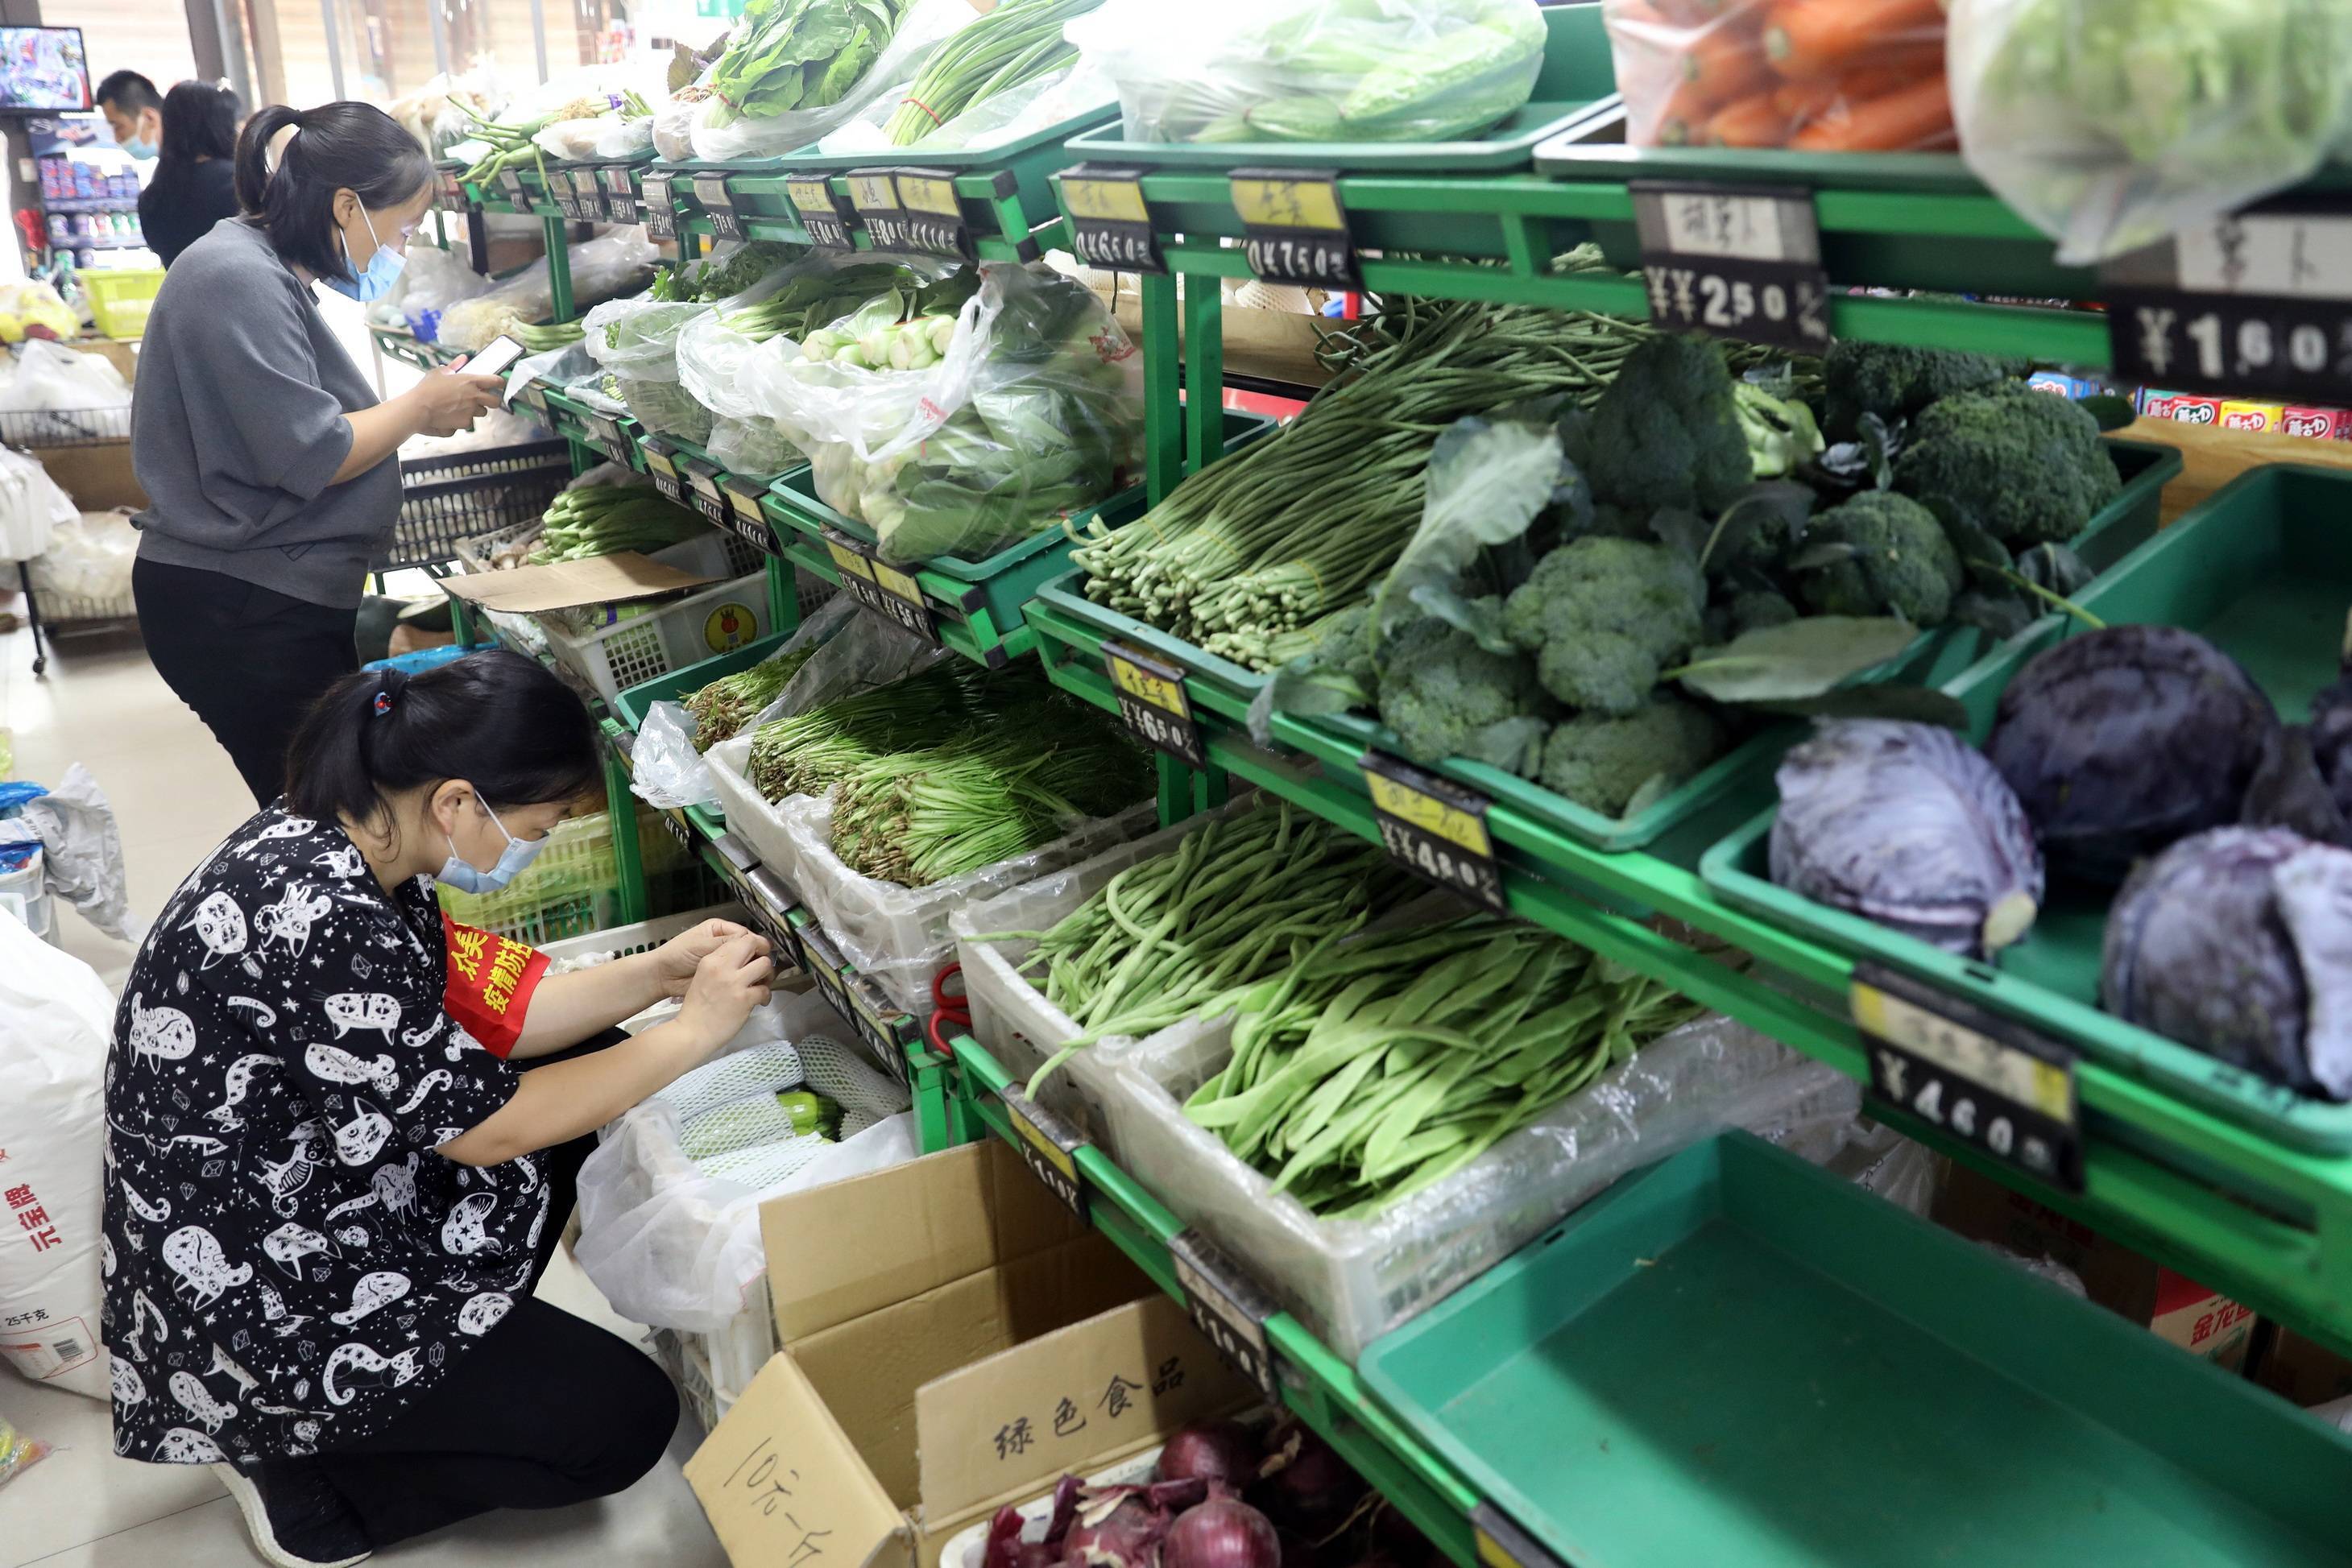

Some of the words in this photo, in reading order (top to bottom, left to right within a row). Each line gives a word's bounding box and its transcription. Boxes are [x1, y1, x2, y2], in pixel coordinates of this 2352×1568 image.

[4, 1183, 62, 1252] 元宝牌
[5, 1308, 49, 1326] 25千克
[994, 1356, 1185, 1461] 绿色食品
